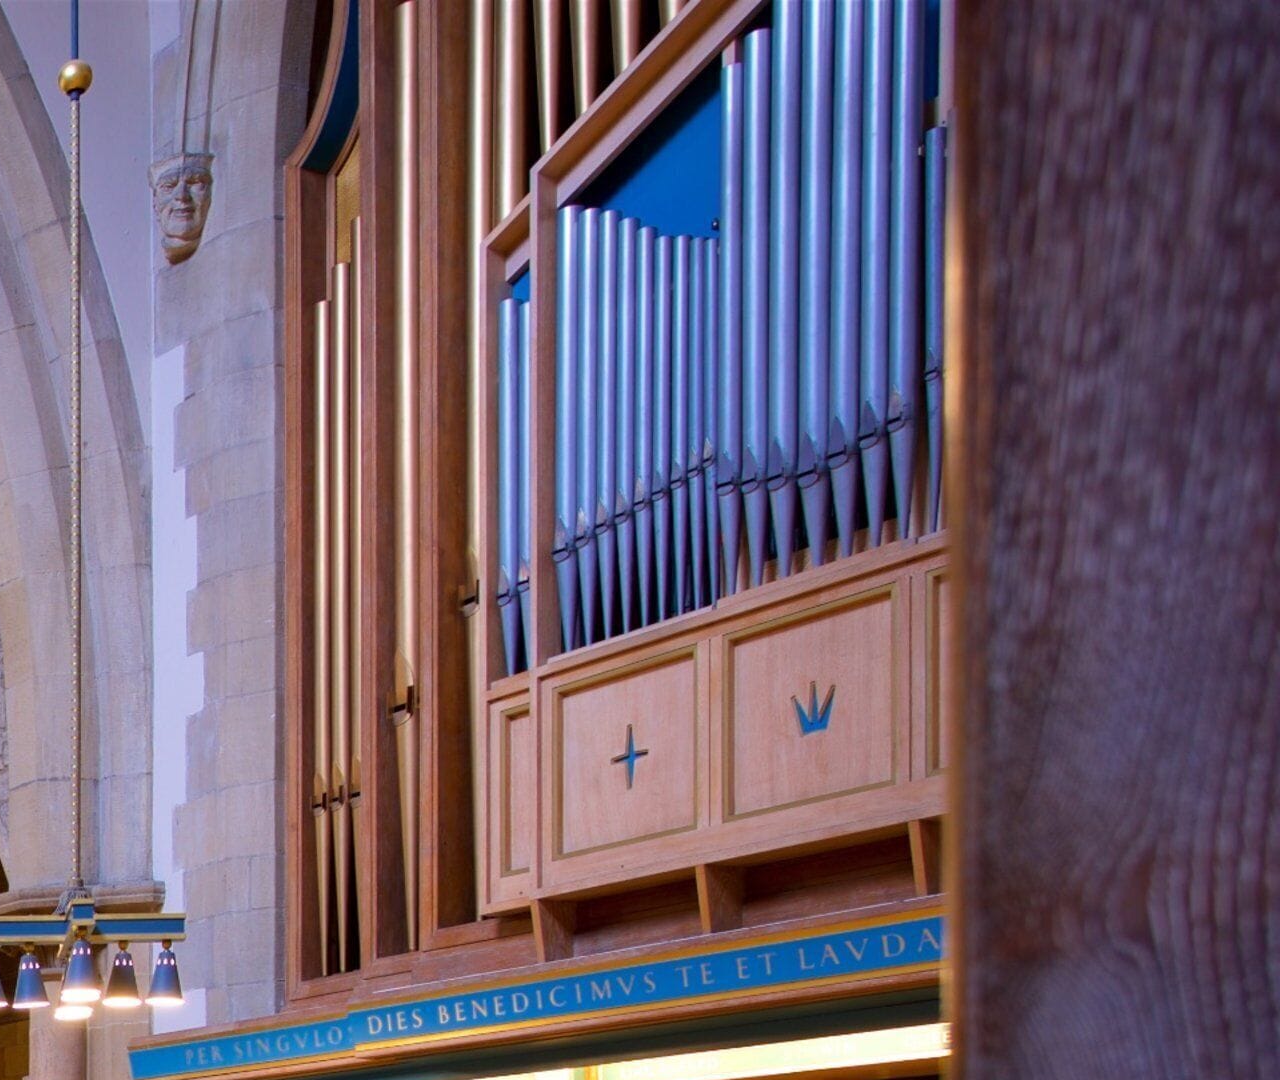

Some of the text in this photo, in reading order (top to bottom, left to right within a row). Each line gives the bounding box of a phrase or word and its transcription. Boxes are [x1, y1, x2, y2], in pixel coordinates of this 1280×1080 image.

[185, 1045, 224, 1065] PER
[367, 1008, 423, 1035] DIES
[439, 971, 656, 1024] BENEDICIMVS
[675, 963, 715, 988] TE
[736, 952, 776, 979] ET
